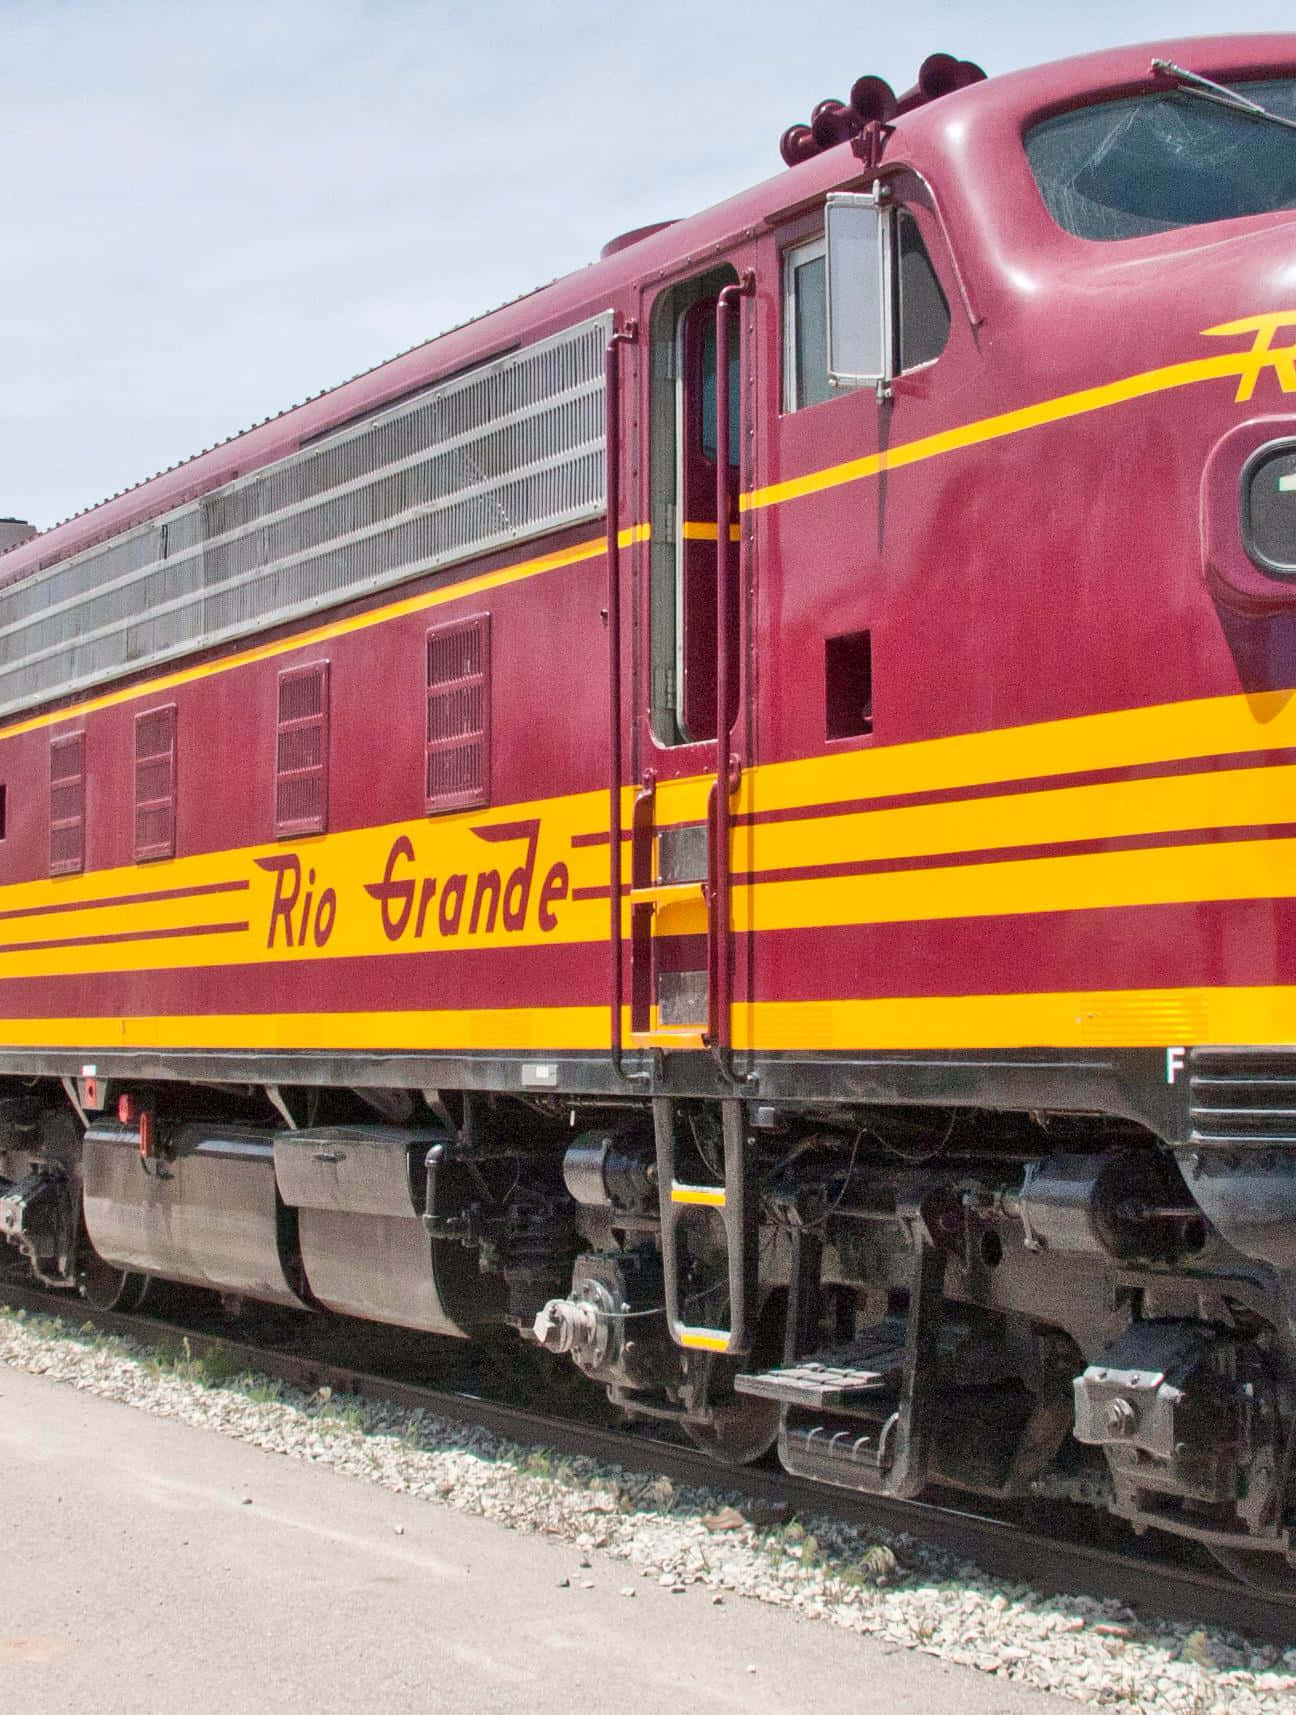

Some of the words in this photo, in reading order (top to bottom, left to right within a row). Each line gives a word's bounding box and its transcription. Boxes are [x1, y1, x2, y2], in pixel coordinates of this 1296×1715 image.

[254, 853, 337, 949] Rio
[364, 818, 569, 941] Grande
[1167, 1047, 1185, 1084] F
